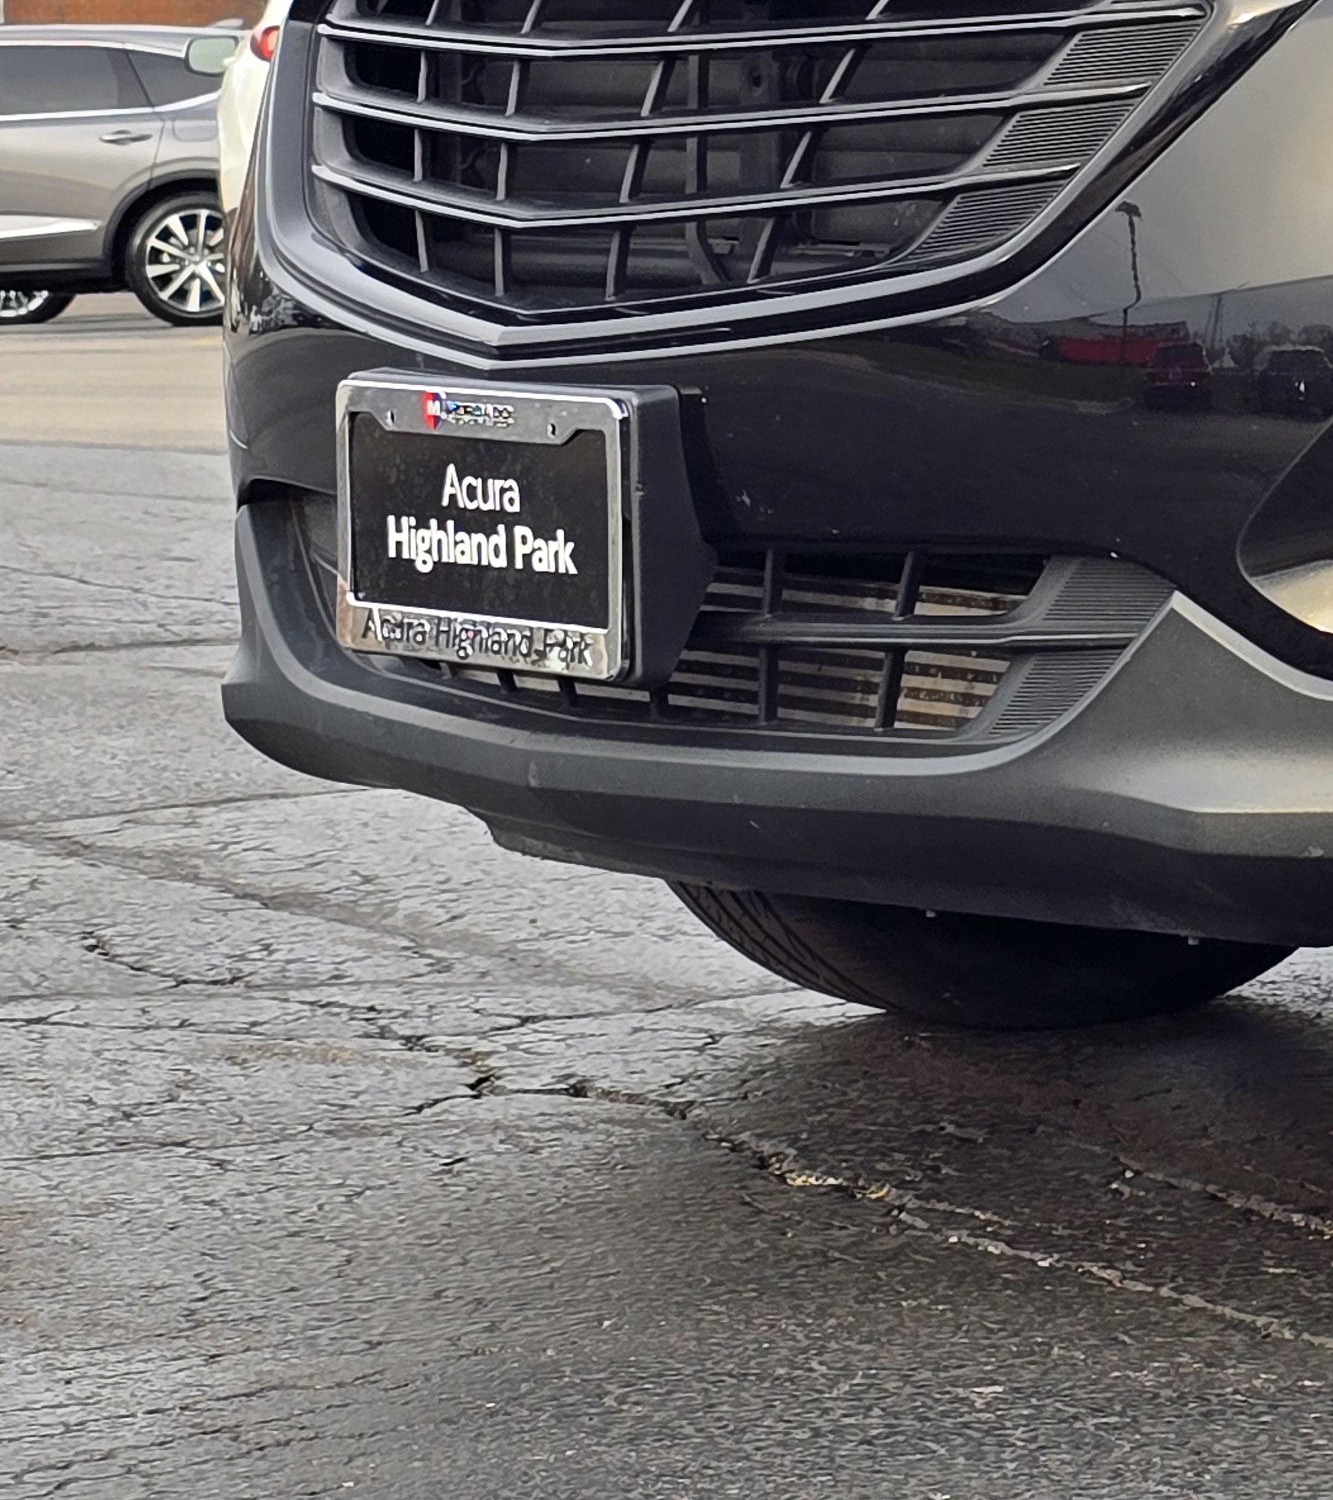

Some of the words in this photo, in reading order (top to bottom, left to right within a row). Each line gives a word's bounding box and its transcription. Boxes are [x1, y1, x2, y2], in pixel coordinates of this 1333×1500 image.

[442, 463, 521, 513] Acura
[387, 515, 507, 573] Highland
[513, 525, 578, 575] Park
[362, 607, 430, 645] Acura
